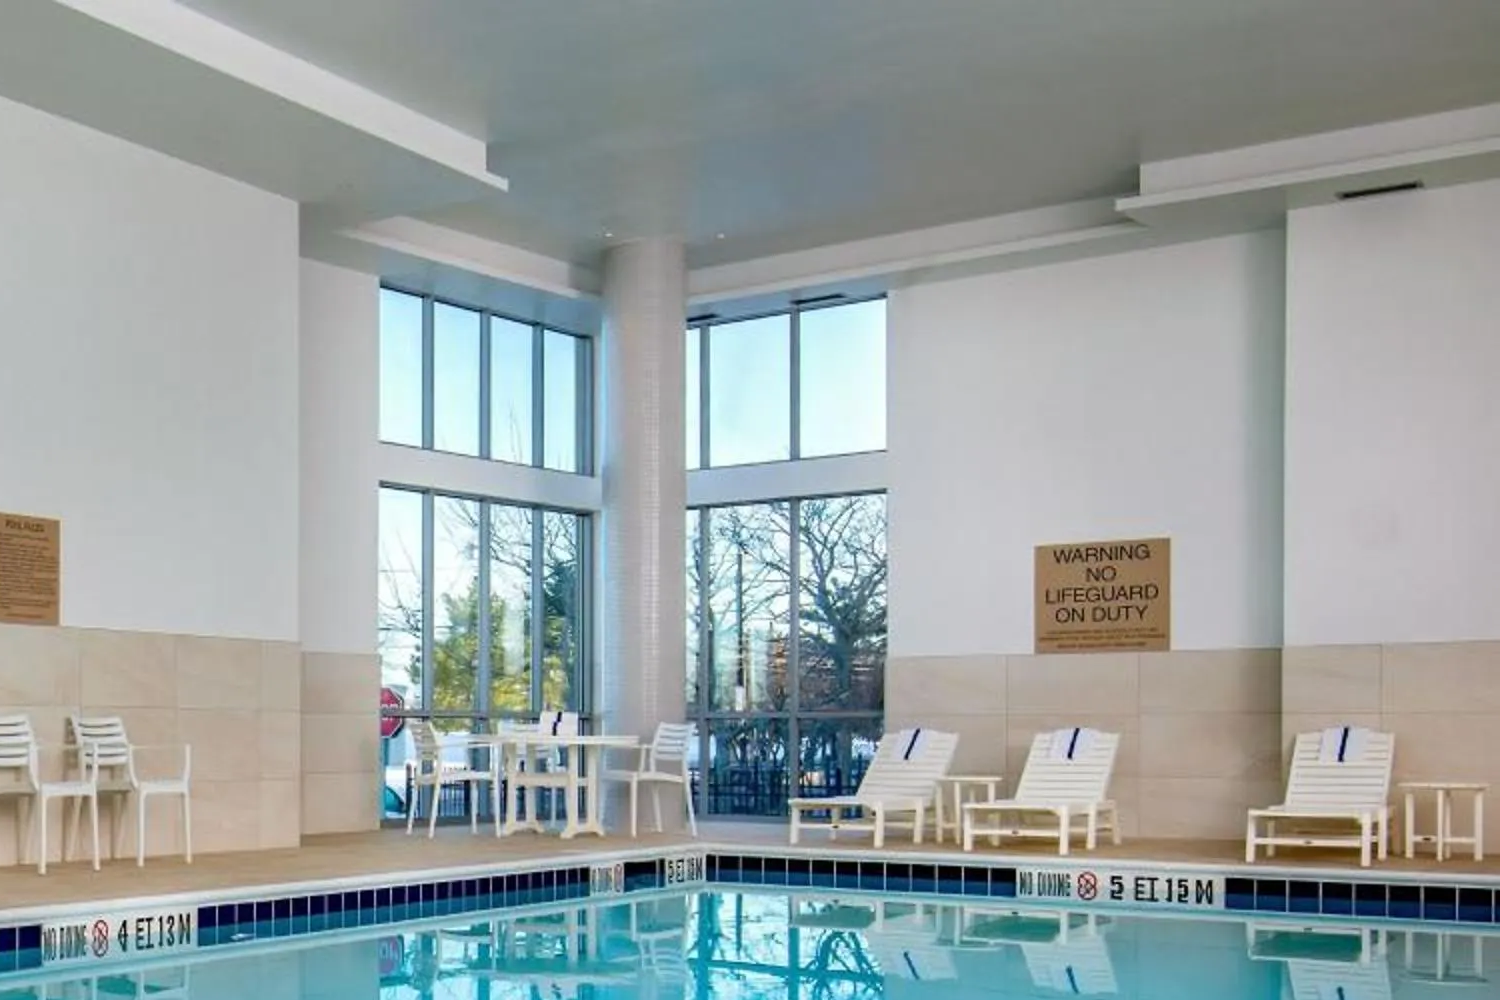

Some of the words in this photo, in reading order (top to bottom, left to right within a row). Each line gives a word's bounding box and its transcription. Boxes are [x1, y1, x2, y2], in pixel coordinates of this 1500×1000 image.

[1053, 544, 1150, 564] WARNING
[1086, 566, 1117, 582] NO
[1045, 583, 1159, 604] LIFEGUARD
[1056, 607, 1085, 623] ON
[1091, 605, 1148, 622] DUTY
[1110, 876, 1124, 899] 5
[117, 920, 128, 948] 4
